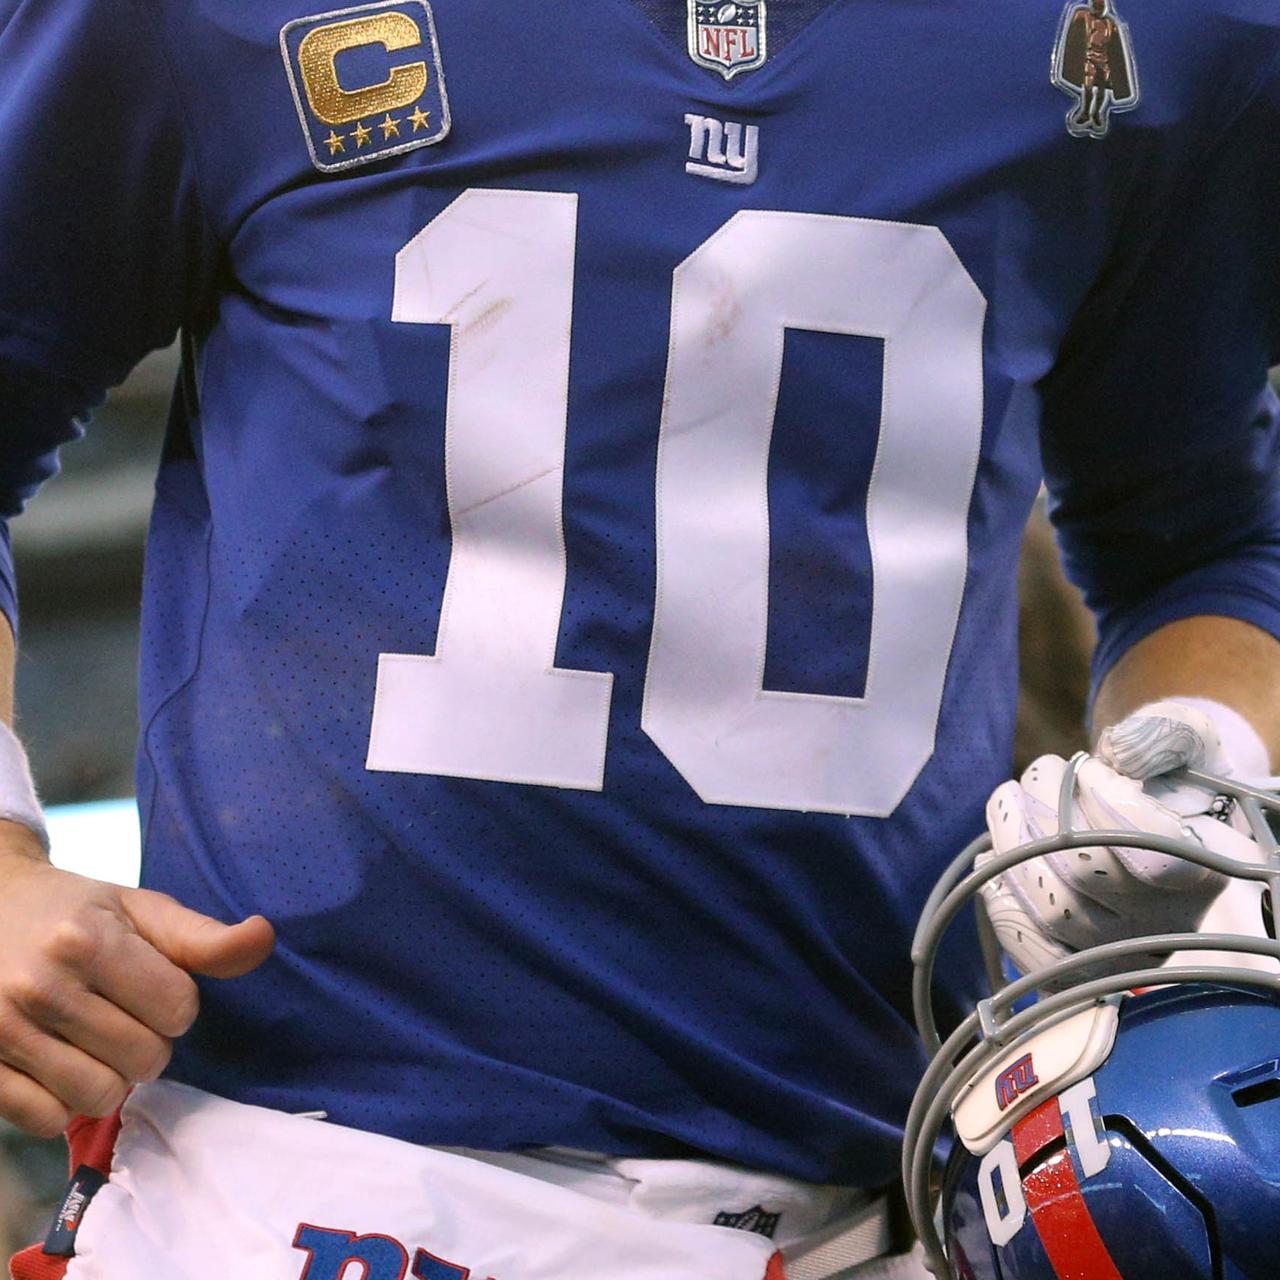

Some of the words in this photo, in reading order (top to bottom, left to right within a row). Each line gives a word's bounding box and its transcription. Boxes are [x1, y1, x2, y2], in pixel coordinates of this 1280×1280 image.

[297, 11, 428, 125] C
[703, 26, 755, 61] NFL
[684, 113, 759, 185] ny
[366, 188, 987, 818] 10
